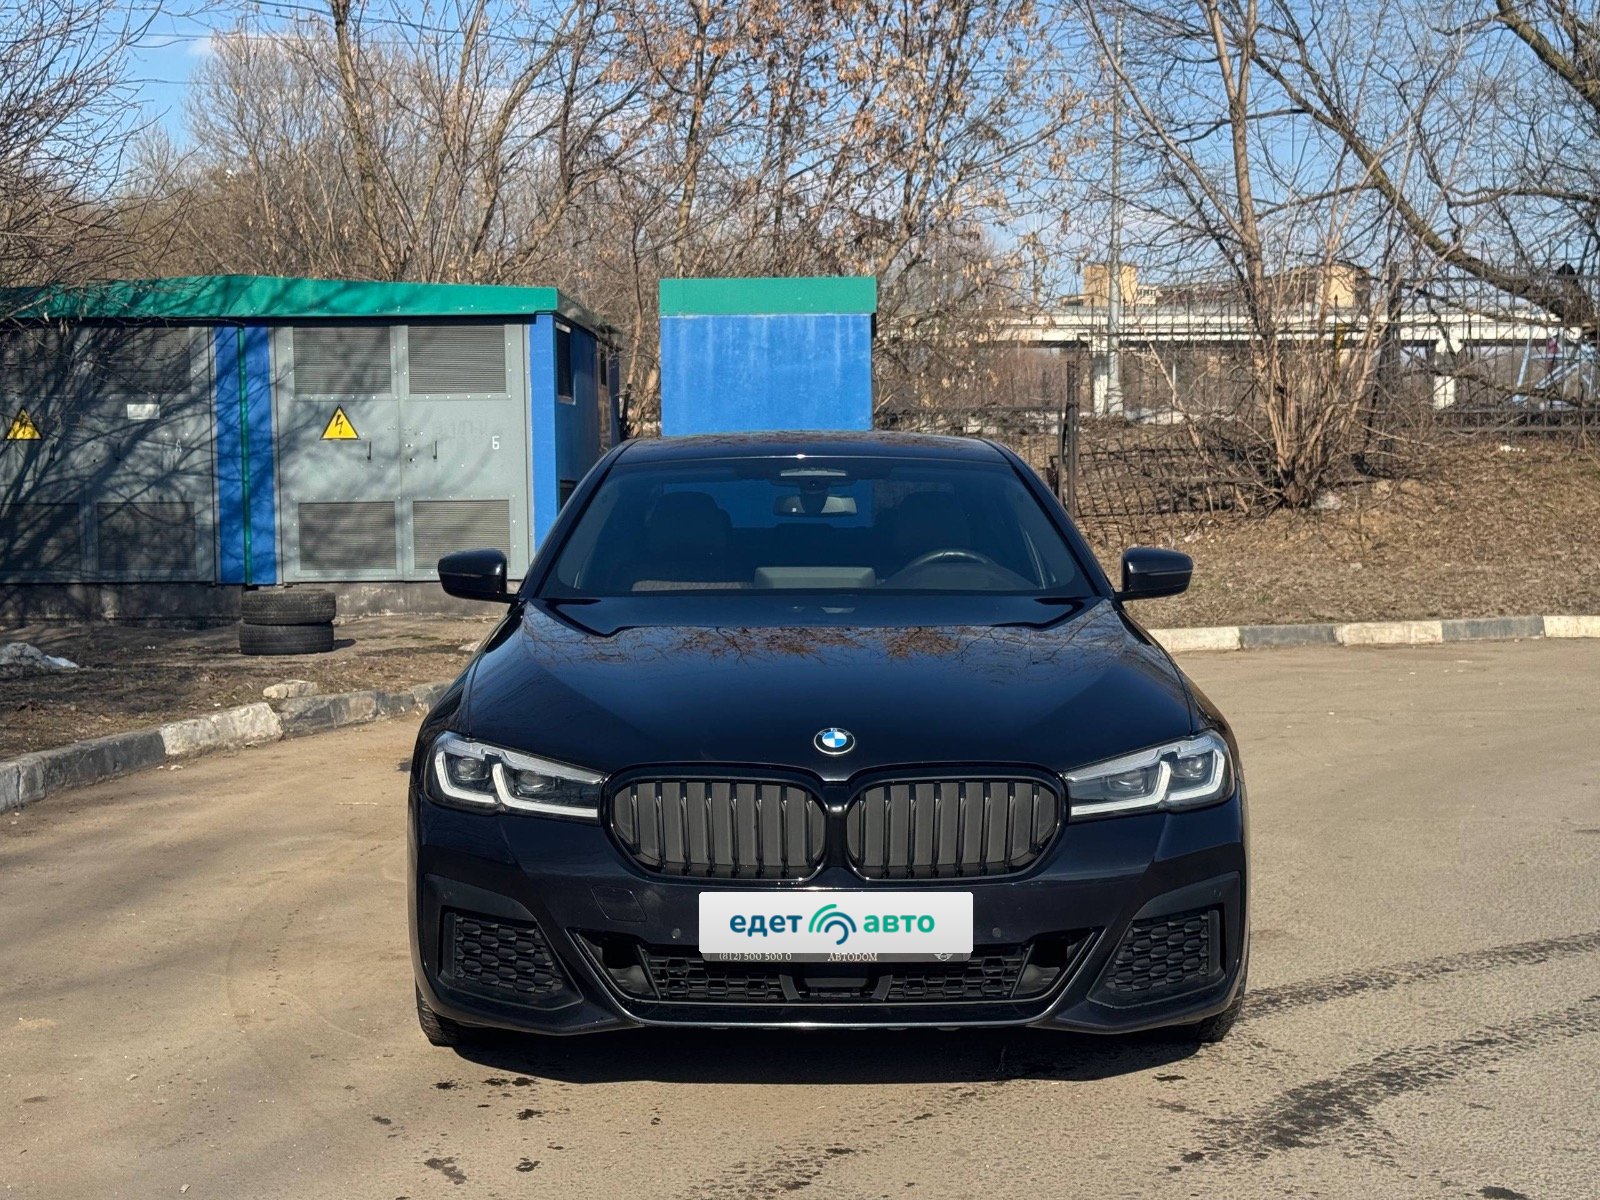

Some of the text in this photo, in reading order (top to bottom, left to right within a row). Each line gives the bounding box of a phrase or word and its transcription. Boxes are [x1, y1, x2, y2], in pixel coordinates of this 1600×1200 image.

[719, 952, 741, 961] (812)
[744, 952, 762, 961] 500
[765, 952, 783, 961] 500
